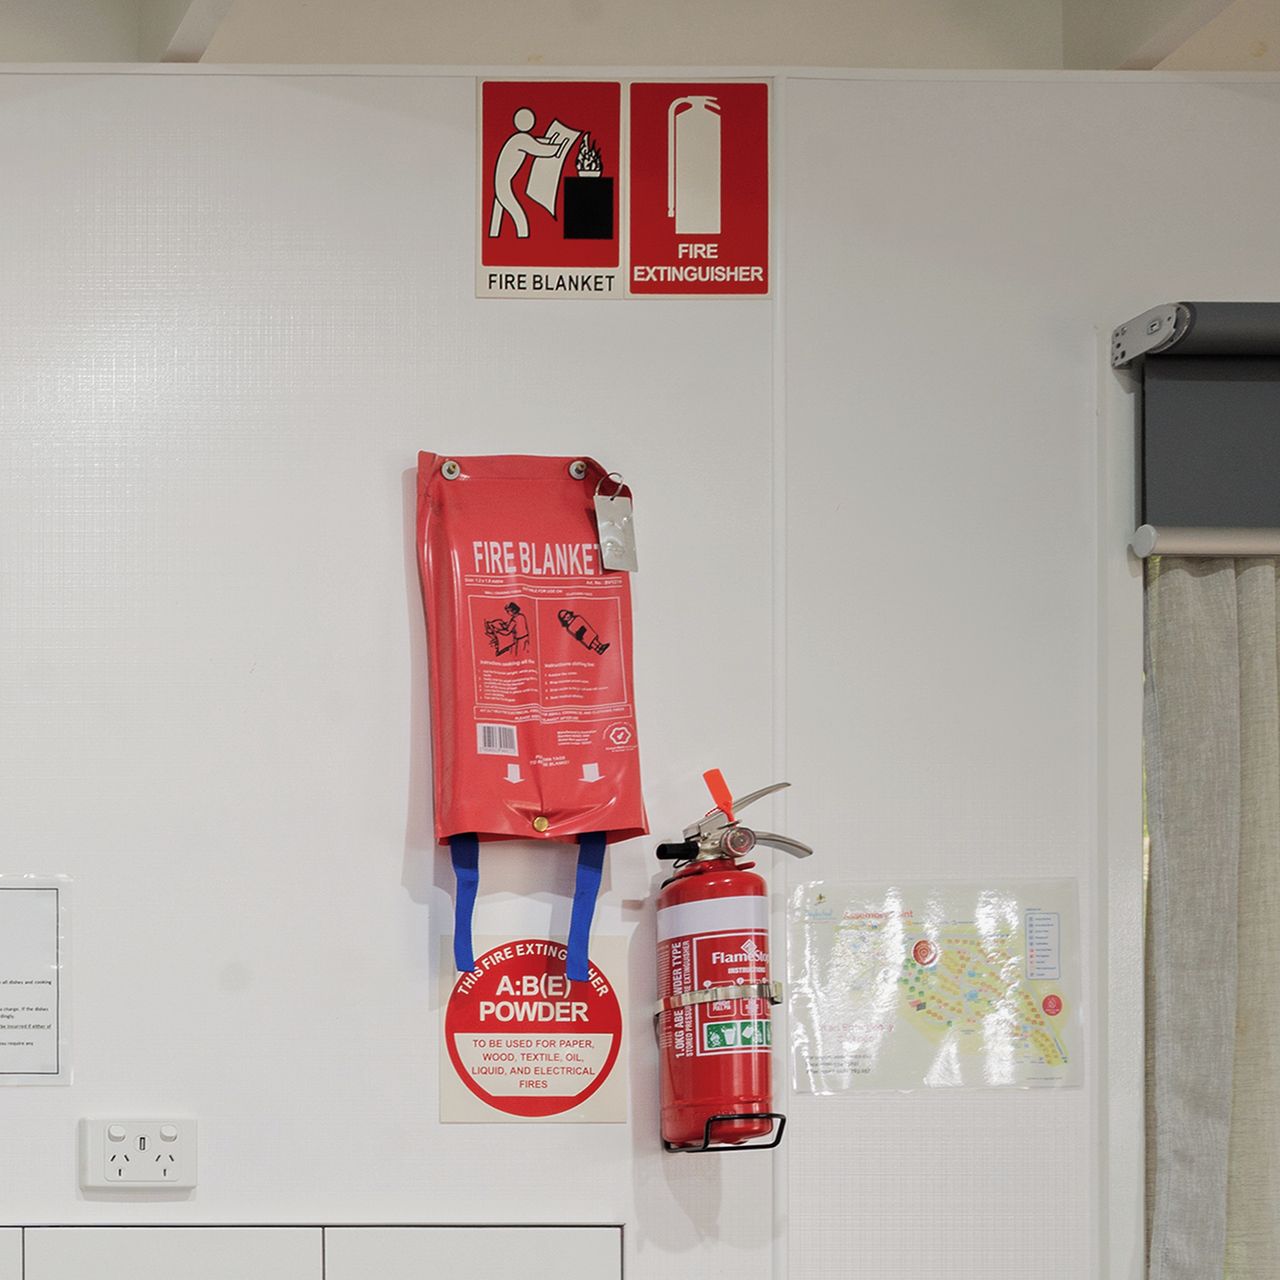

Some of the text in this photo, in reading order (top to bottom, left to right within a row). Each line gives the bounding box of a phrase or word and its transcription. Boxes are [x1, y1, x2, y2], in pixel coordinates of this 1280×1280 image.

[678, 244, 719, 259] FIRE
[633, 266, 764, 282] EXTINGUISHER
[488, 274, 615, 292] FIRE BLANKET
[472, 541, 517, 574] FIRE
[671, 942, 682, 967] TYPE
[457, 966, 484, 995] THIS
[481, 946, 514, 970] FIRE
[479, 1002, 590, 1022] POWDER
[674, 1009, 684, 1028] ABE
[473, 1040, 595, 1049] TO BE USED FOR PAPER,
[482, 1053, 517, 1062] WOOD,
[510, 1066, 531, 1075] AND
[534, 1066, 595, 1075] ELECTRICAL
[519, 1080, 548, 1089] FIRES
